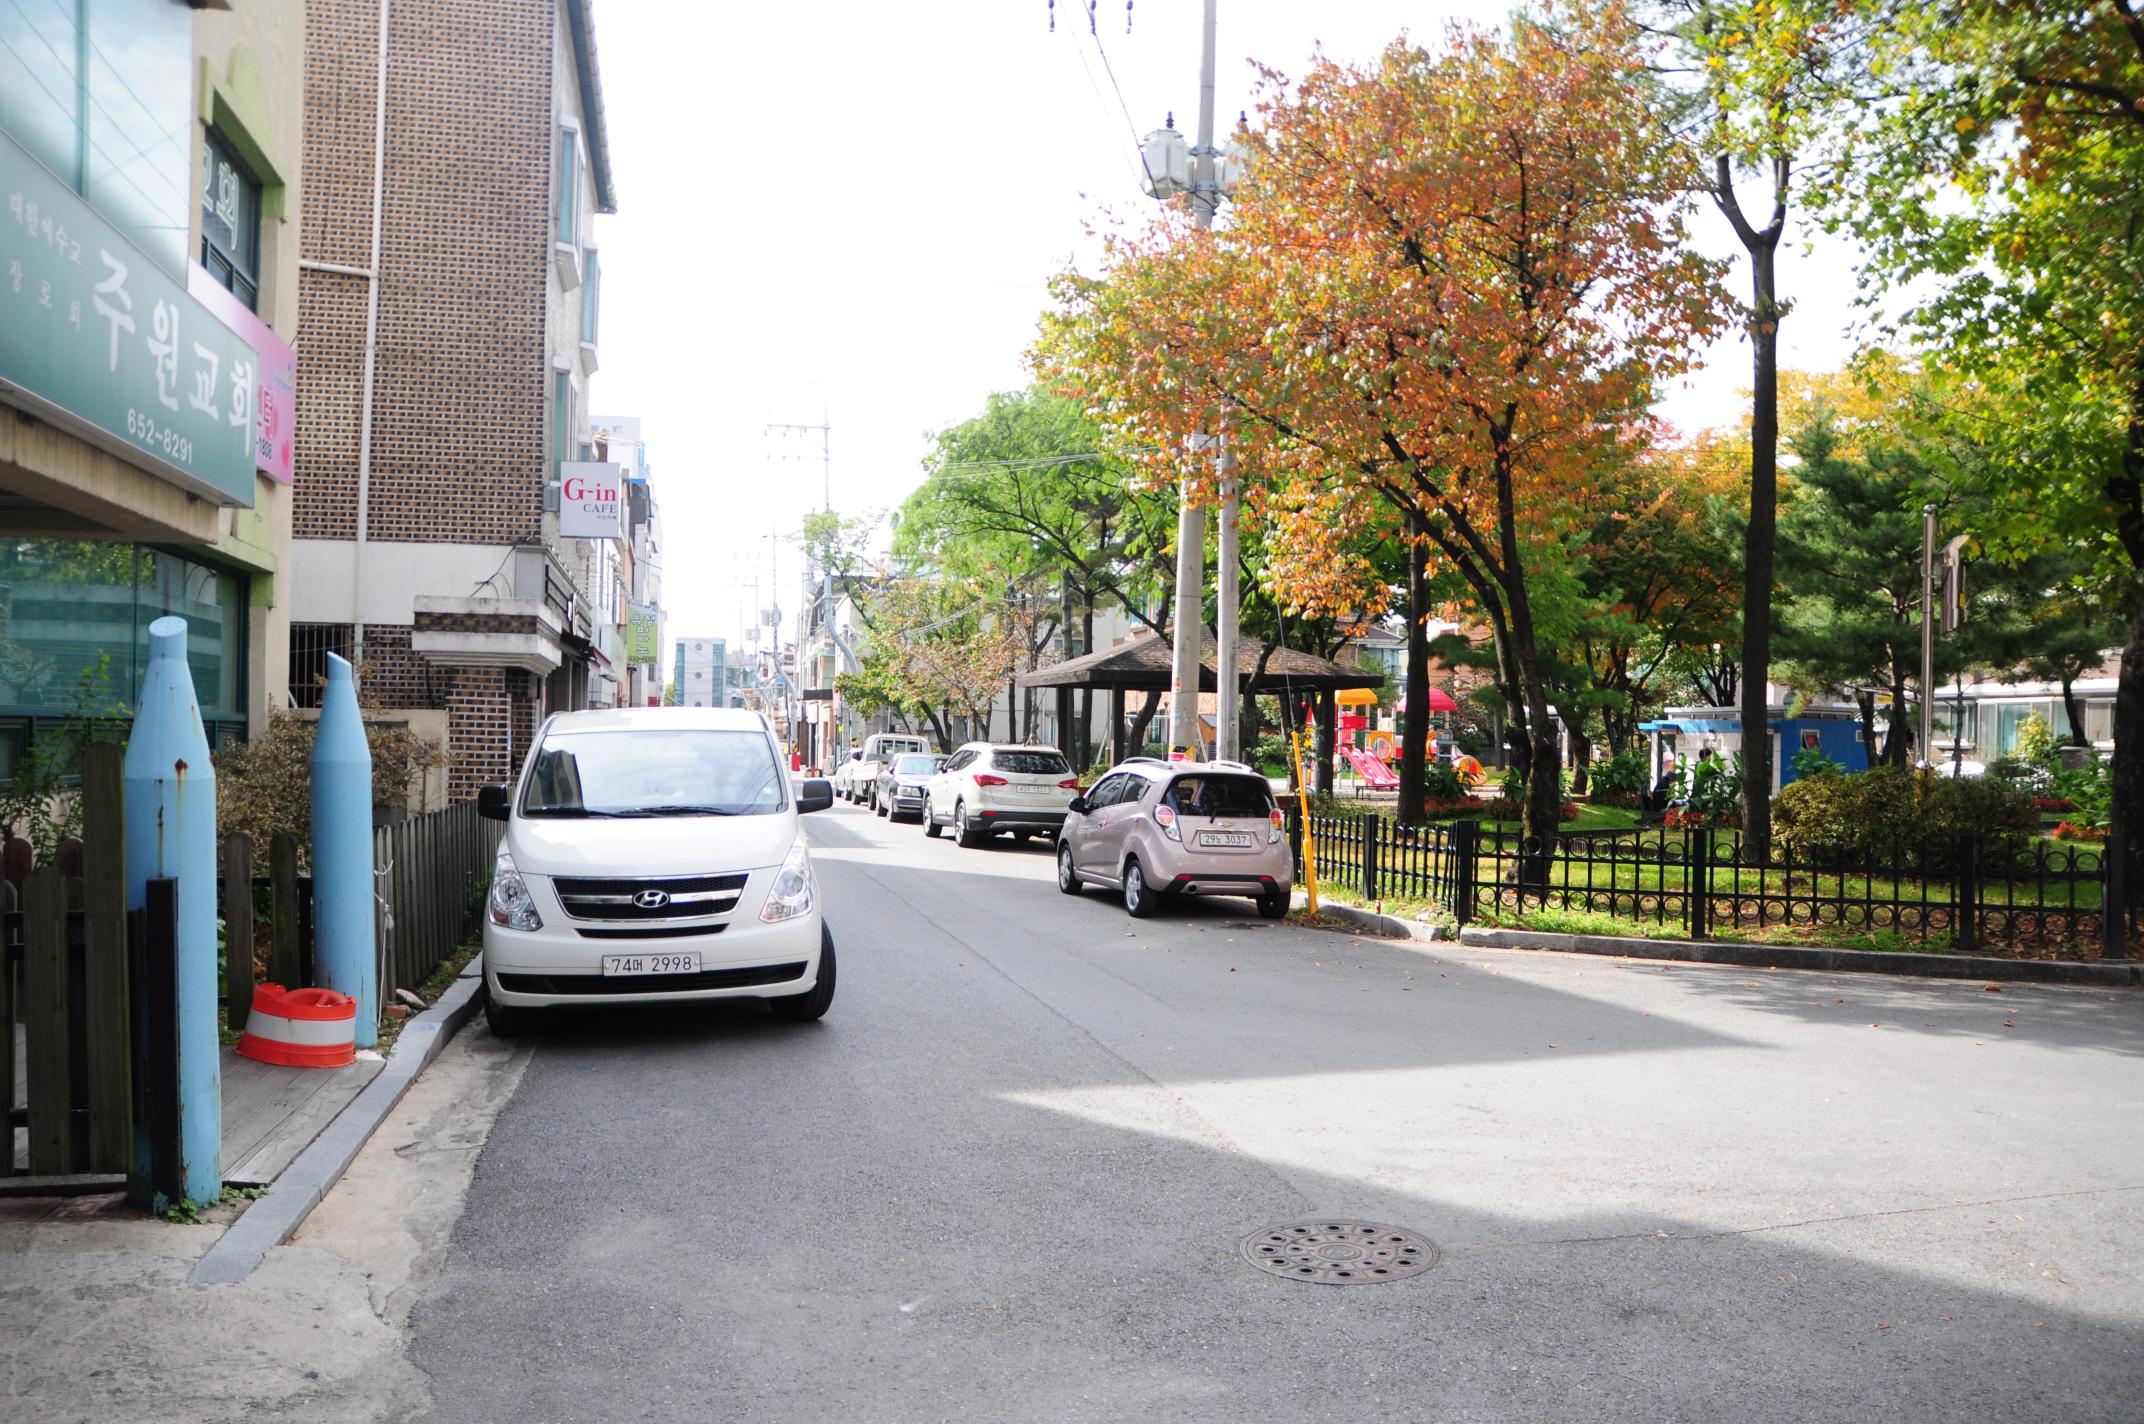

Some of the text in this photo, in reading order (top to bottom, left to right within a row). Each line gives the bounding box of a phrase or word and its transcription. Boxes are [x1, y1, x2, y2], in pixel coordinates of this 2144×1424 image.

[92, 247, 253, 458] 주원교회
[127, 408, 193, 465] 652-8291
[563, 477, 617, 502] G-in
[583, 503, 618, 514] CAFE
[1225, 835, 1247, 845] 3037
[651, 956, 692, 973] 2998
